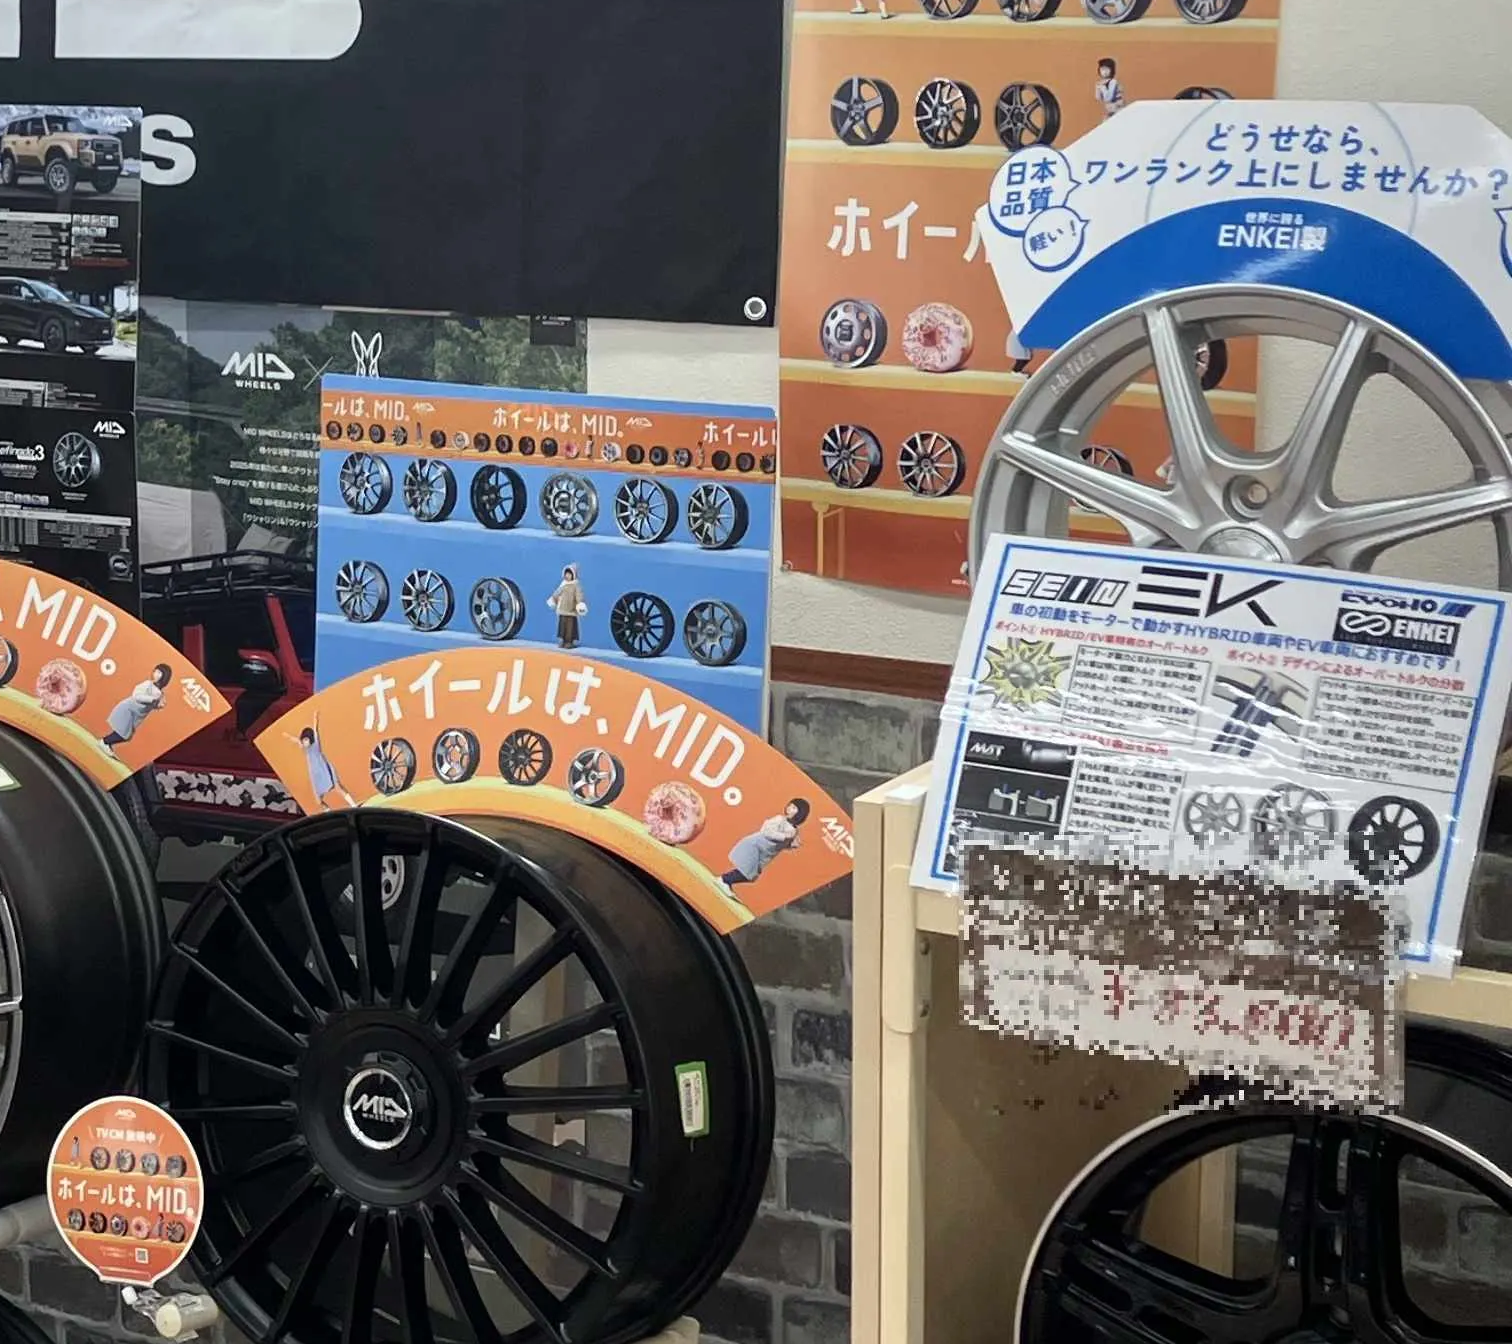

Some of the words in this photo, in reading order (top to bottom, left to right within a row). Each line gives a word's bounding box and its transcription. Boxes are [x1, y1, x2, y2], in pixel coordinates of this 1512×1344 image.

[1205, 122, 1384, 156] どうせなら、
[1005, 158, 1057, 186] 日本
[999, 185, 1054, 218] 品質
[1217, 224, 1329, 252] ENKEI製
[221, 351, 296, 381] MID
[1392, 618, 1455, 645] ENKEI
